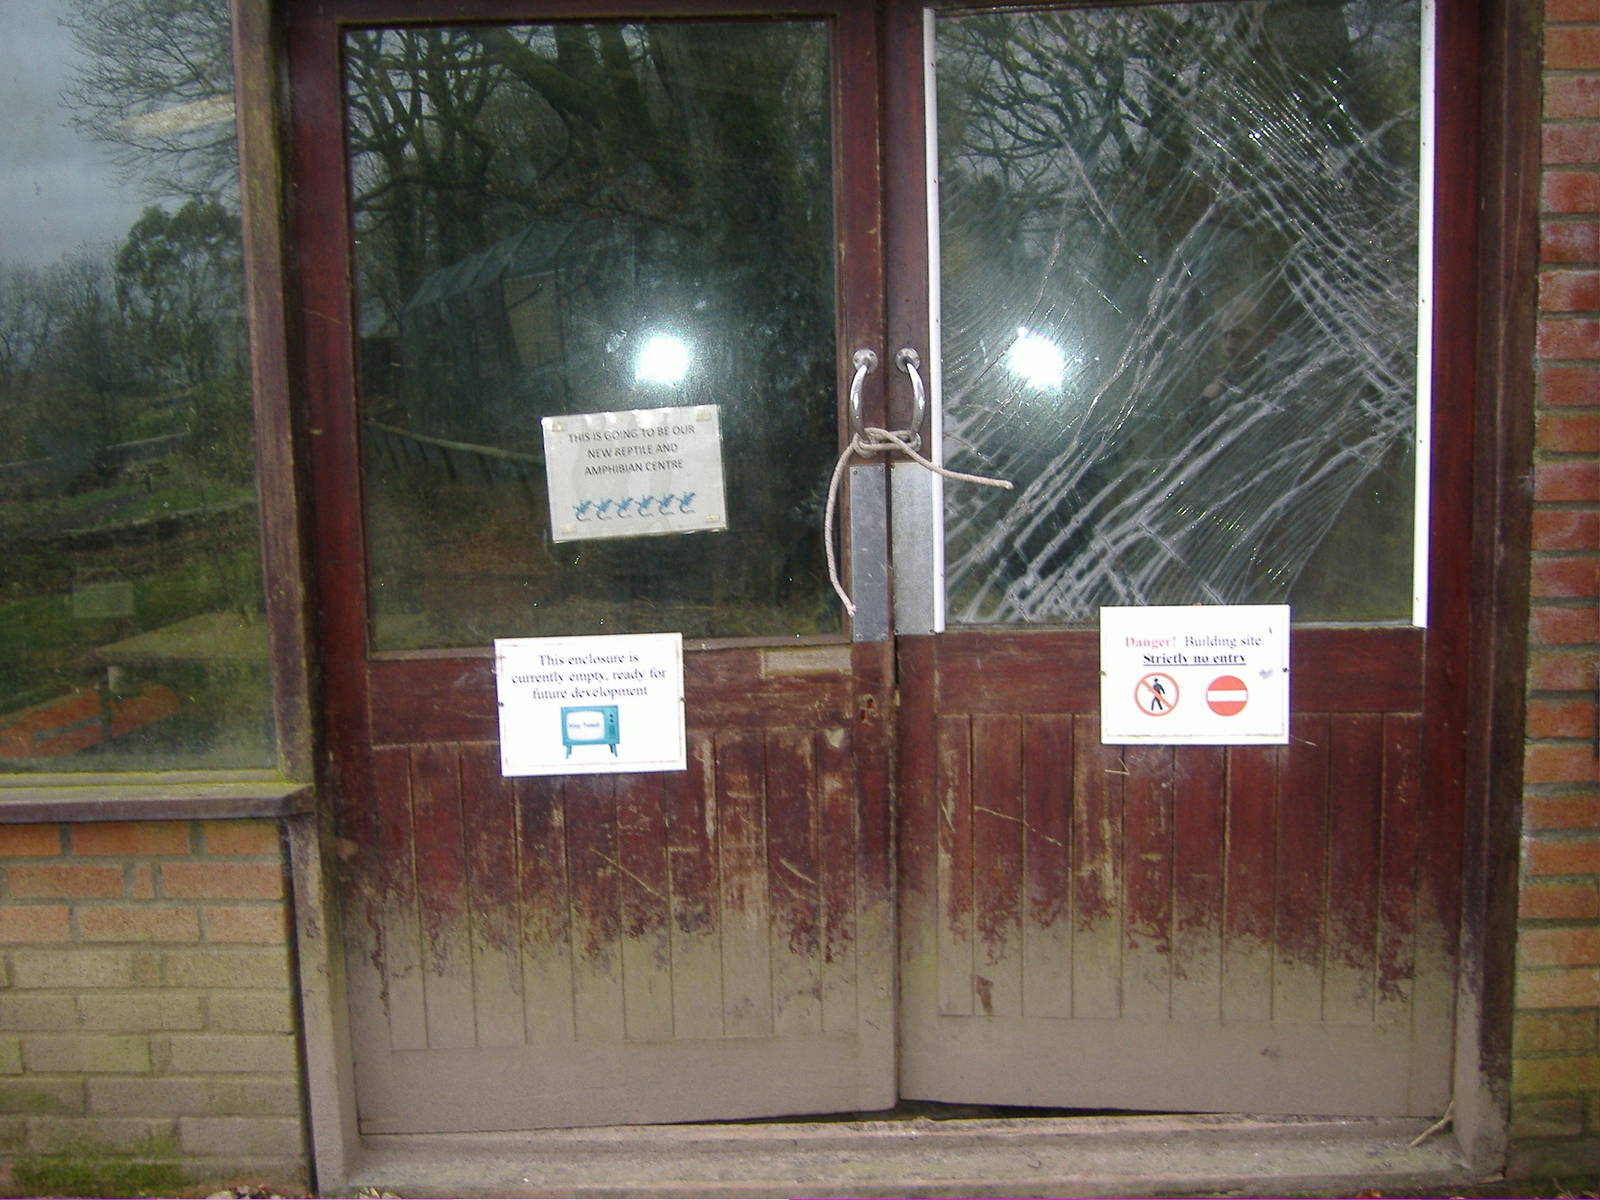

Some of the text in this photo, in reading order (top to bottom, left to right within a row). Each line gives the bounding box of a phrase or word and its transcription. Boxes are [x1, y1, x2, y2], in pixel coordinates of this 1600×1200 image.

[568, 424, 695, 443] THIS IS GOING TO BE OUR
[587, 443, 678, 459] NEW REPTILE AND
[584, 460, 684, 476] AMPHIBIAN CENTRE
[1125, 636, 1176, 648] Danger!
[1185, 636, 1237, 648] Building
[538, 652, 639, 666] This enclosure is
[1143, 654, 1246, 663] Strictly no entry
[511, 672, 563, 684] currently
[613, 668, 644, 681] ready
[650, 667, 667, 679] for
[533, 686, 648, 699] future development
